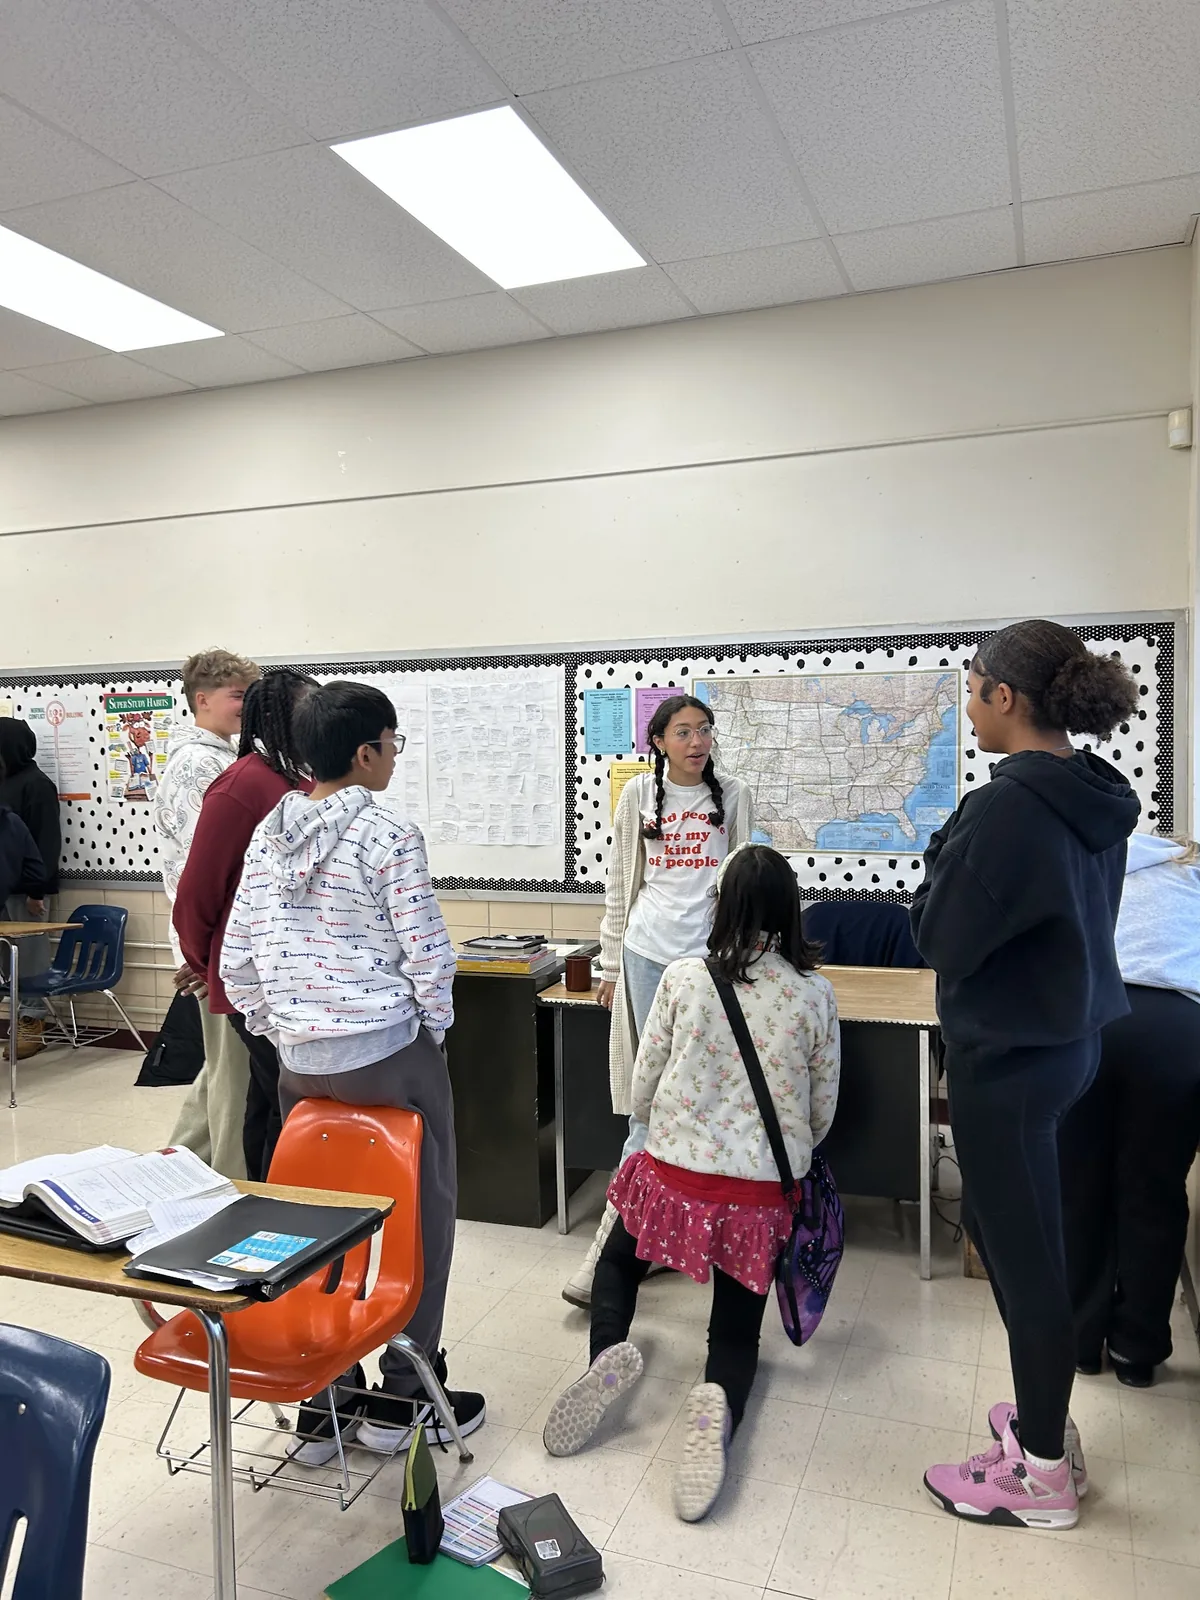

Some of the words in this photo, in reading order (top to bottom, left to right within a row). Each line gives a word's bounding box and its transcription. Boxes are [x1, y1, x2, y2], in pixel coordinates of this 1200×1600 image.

[128, 698, 146, 709] STUDY
[147, 697, 169, 708] HABITS
[681, 811, 726, 835] peoe
[656, 832, 681, 841] are
[685, 831, 711, 842] my
[664, 843, 702, 855] kind
[648, 856, 662, 866] of
[665, 856, 719, 869] people
